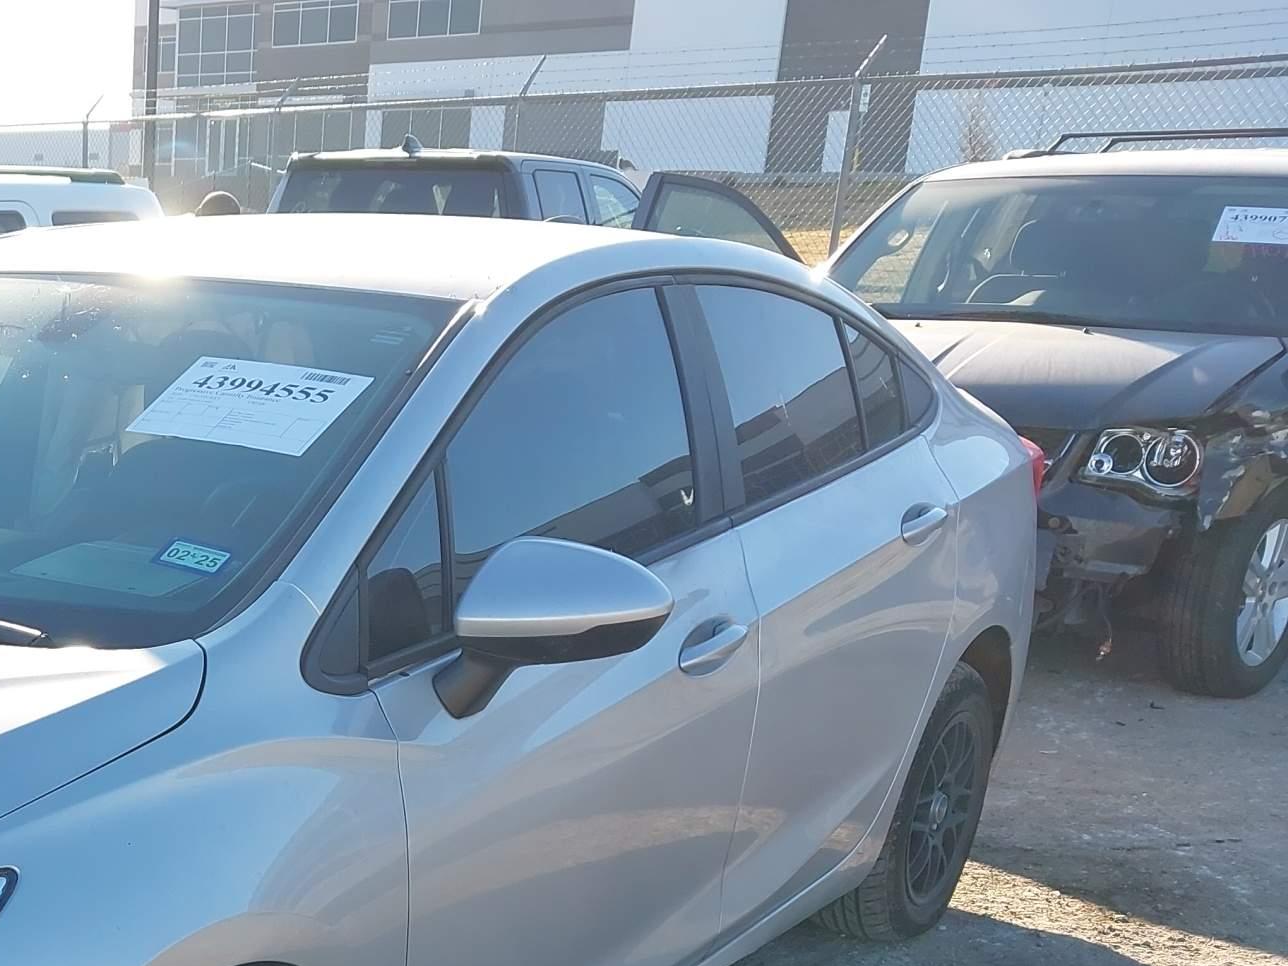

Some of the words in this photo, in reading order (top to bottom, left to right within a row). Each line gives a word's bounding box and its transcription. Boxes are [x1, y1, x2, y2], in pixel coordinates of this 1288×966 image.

[192, 374, 336, 404] 43994555
[166, 547, 192, 561] 02
[193, 554, 222, 568] 25
